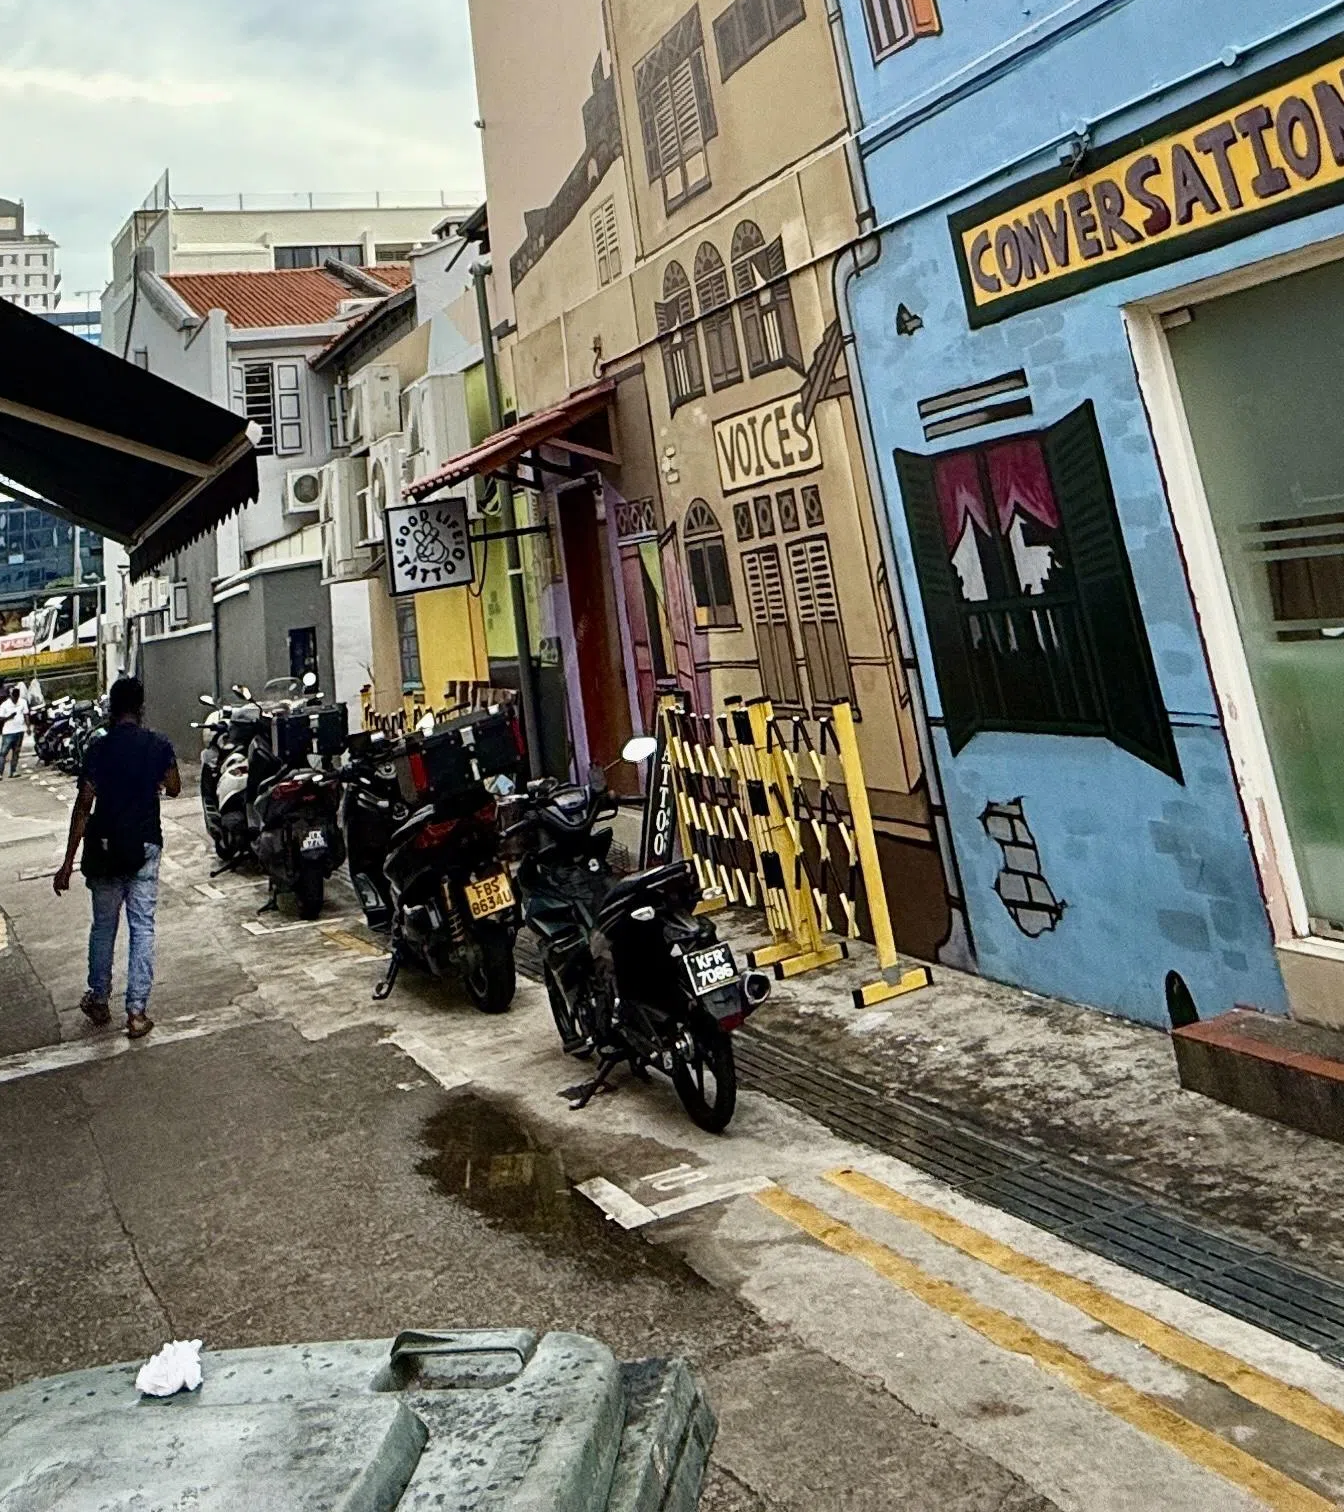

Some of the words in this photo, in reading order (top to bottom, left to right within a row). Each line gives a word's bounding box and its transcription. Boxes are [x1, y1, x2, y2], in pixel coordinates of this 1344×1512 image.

[717, 401, 814, 483] VOICES
[395, 509, 429, 547] GOOD
[436, 510, 464, 540] LIFE
[397, 547, 466, 584] TATTOO
[653, 744, 671, 857] ATTOO
[472, 879, 501, 899] FBS
[695, 949, 726, 970] KFR
